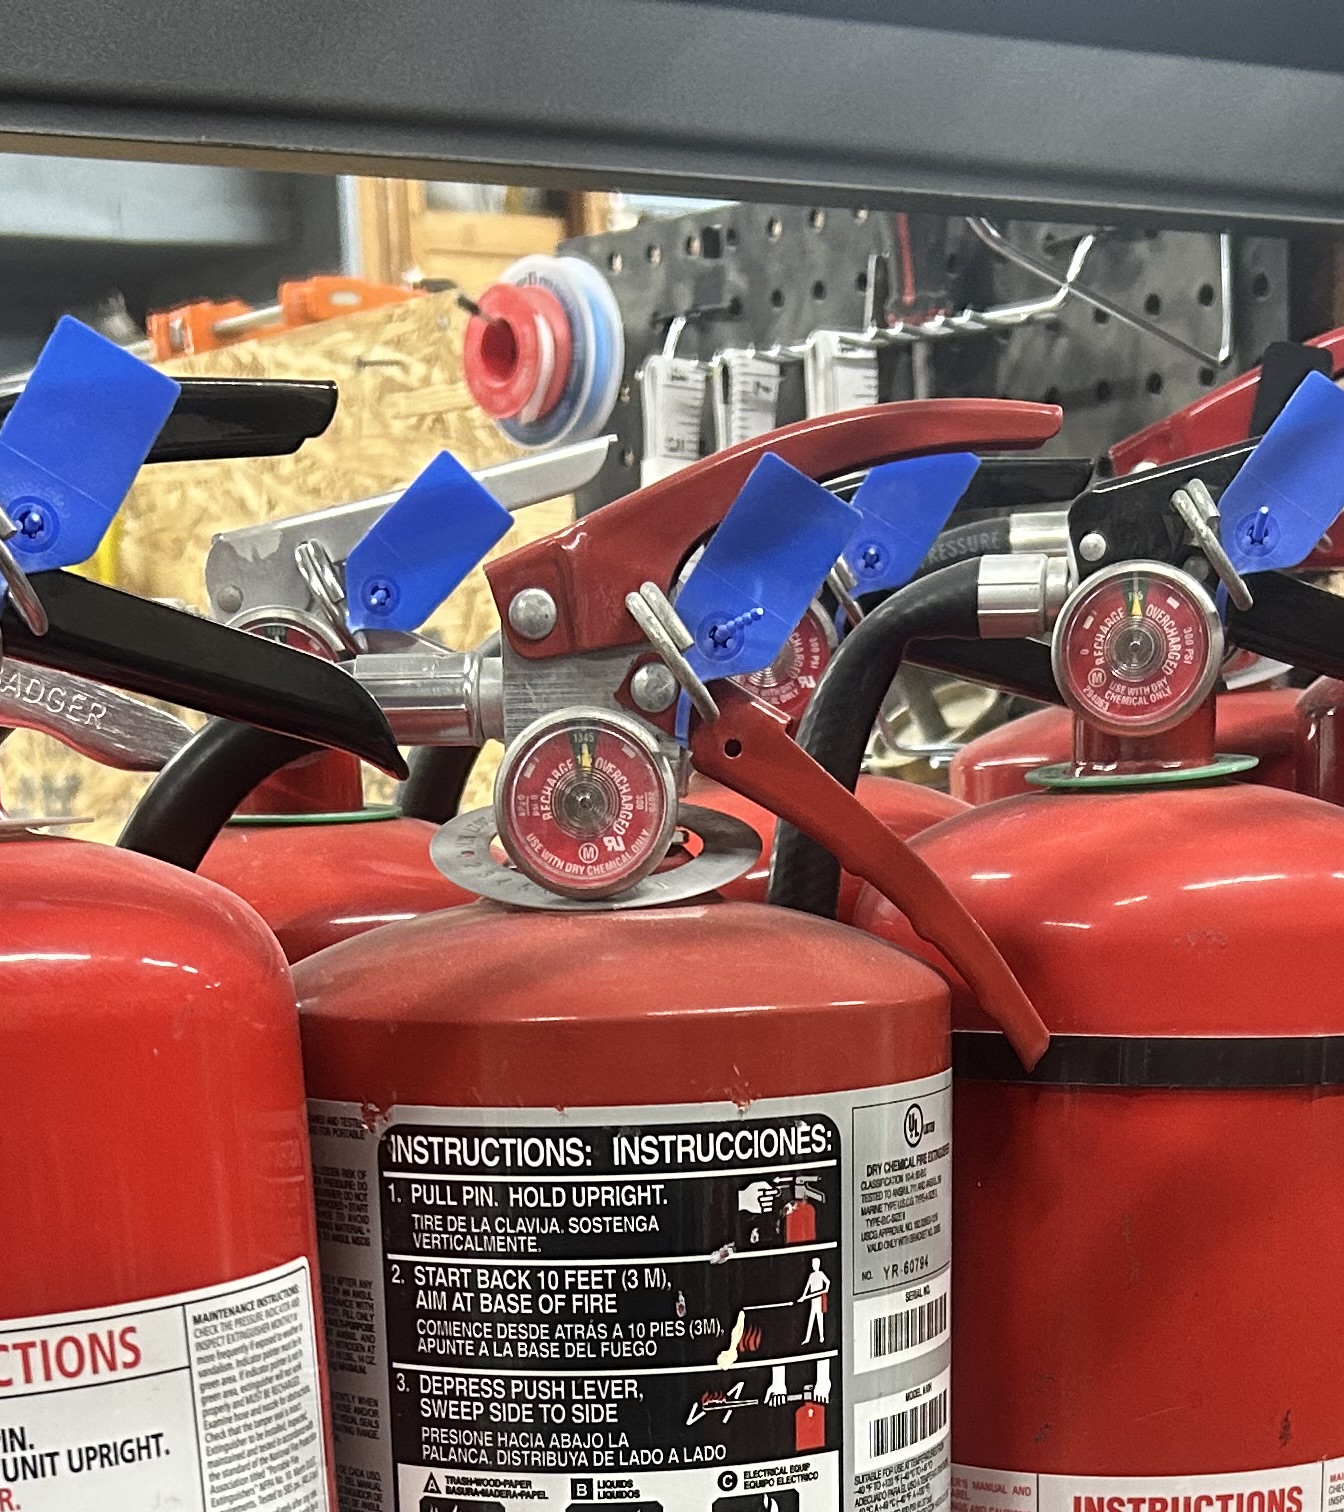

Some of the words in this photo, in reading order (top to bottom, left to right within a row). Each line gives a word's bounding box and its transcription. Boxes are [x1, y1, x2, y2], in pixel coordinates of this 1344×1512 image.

[390, 1135, 593, 1167] INSTRUCTIONS:
[613, 1123, 832, 1165] INSTRUCCIONES:
[387, 1184, 401, 1203] 1.
[411, 1184, 460, 1206] PULL
[462, 1185, 498, 1207] PIN.
[509, 1186, 565, 1208] HOLD
[571, 1184, 668, 1207] UPRIGHT.
[397, 1374, 410, 1393] 3.
[420, 1375, 505, 1399] DEPRESS
[511, 1378, 565, 1399] PUSH
[571, 1380, 643, 1402] LEVER,
[4, 1453, 59, 1482] UNIT
[67, 1433, 170, 1473] UPRIGHT.
